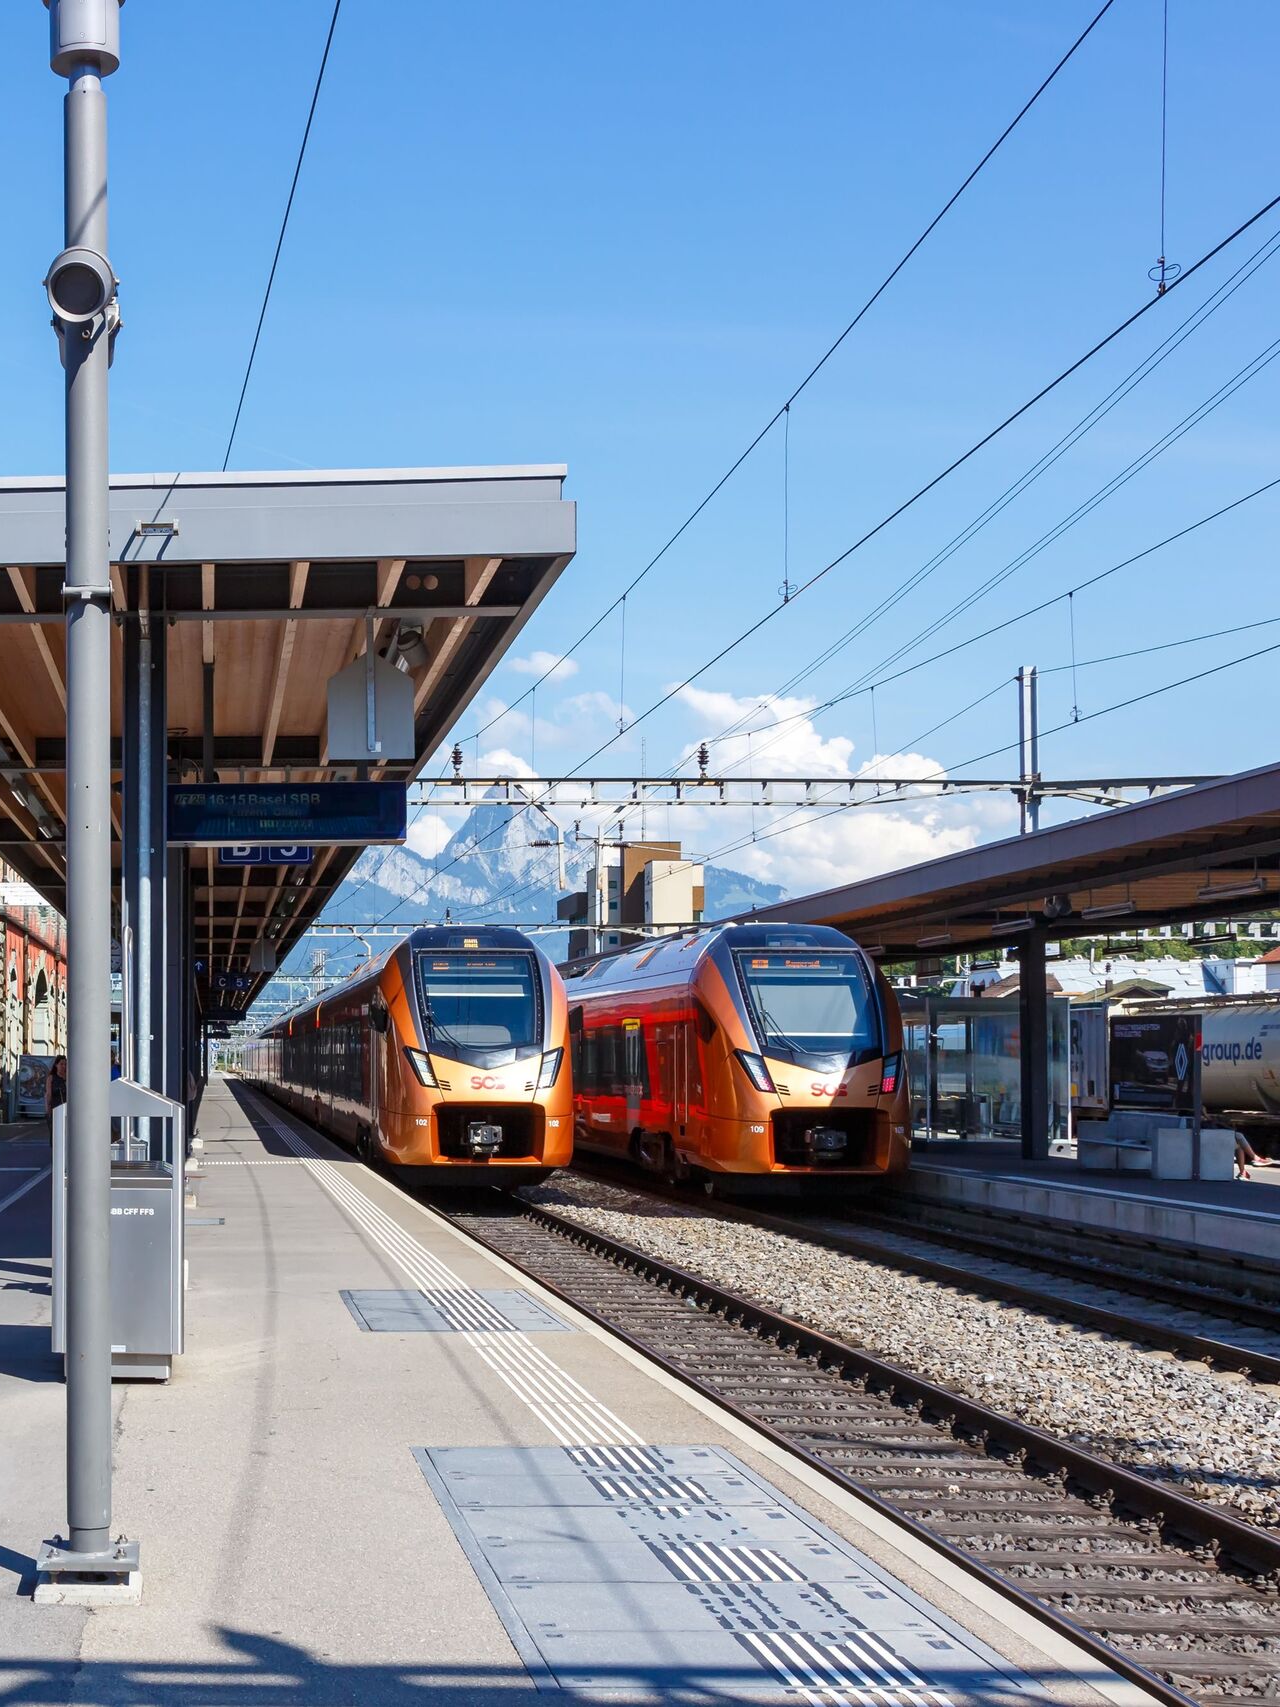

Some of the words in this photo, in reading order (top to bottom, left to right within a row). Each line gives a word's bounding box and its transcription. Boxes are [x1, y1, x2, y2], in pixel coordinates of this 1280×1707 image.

[209, 793, 247, 805] 16:15
[249, 793, 286, 805] Basel
[290, 793, 321, 805] SBB
[218, 978, 226, 987] C
[237, 978, 243, 987] 5
[1202, 1037, 1262, 1067] group.de
[415, 1118, 427, 1126] 102
[750, 1125, 764, 1134] 109
